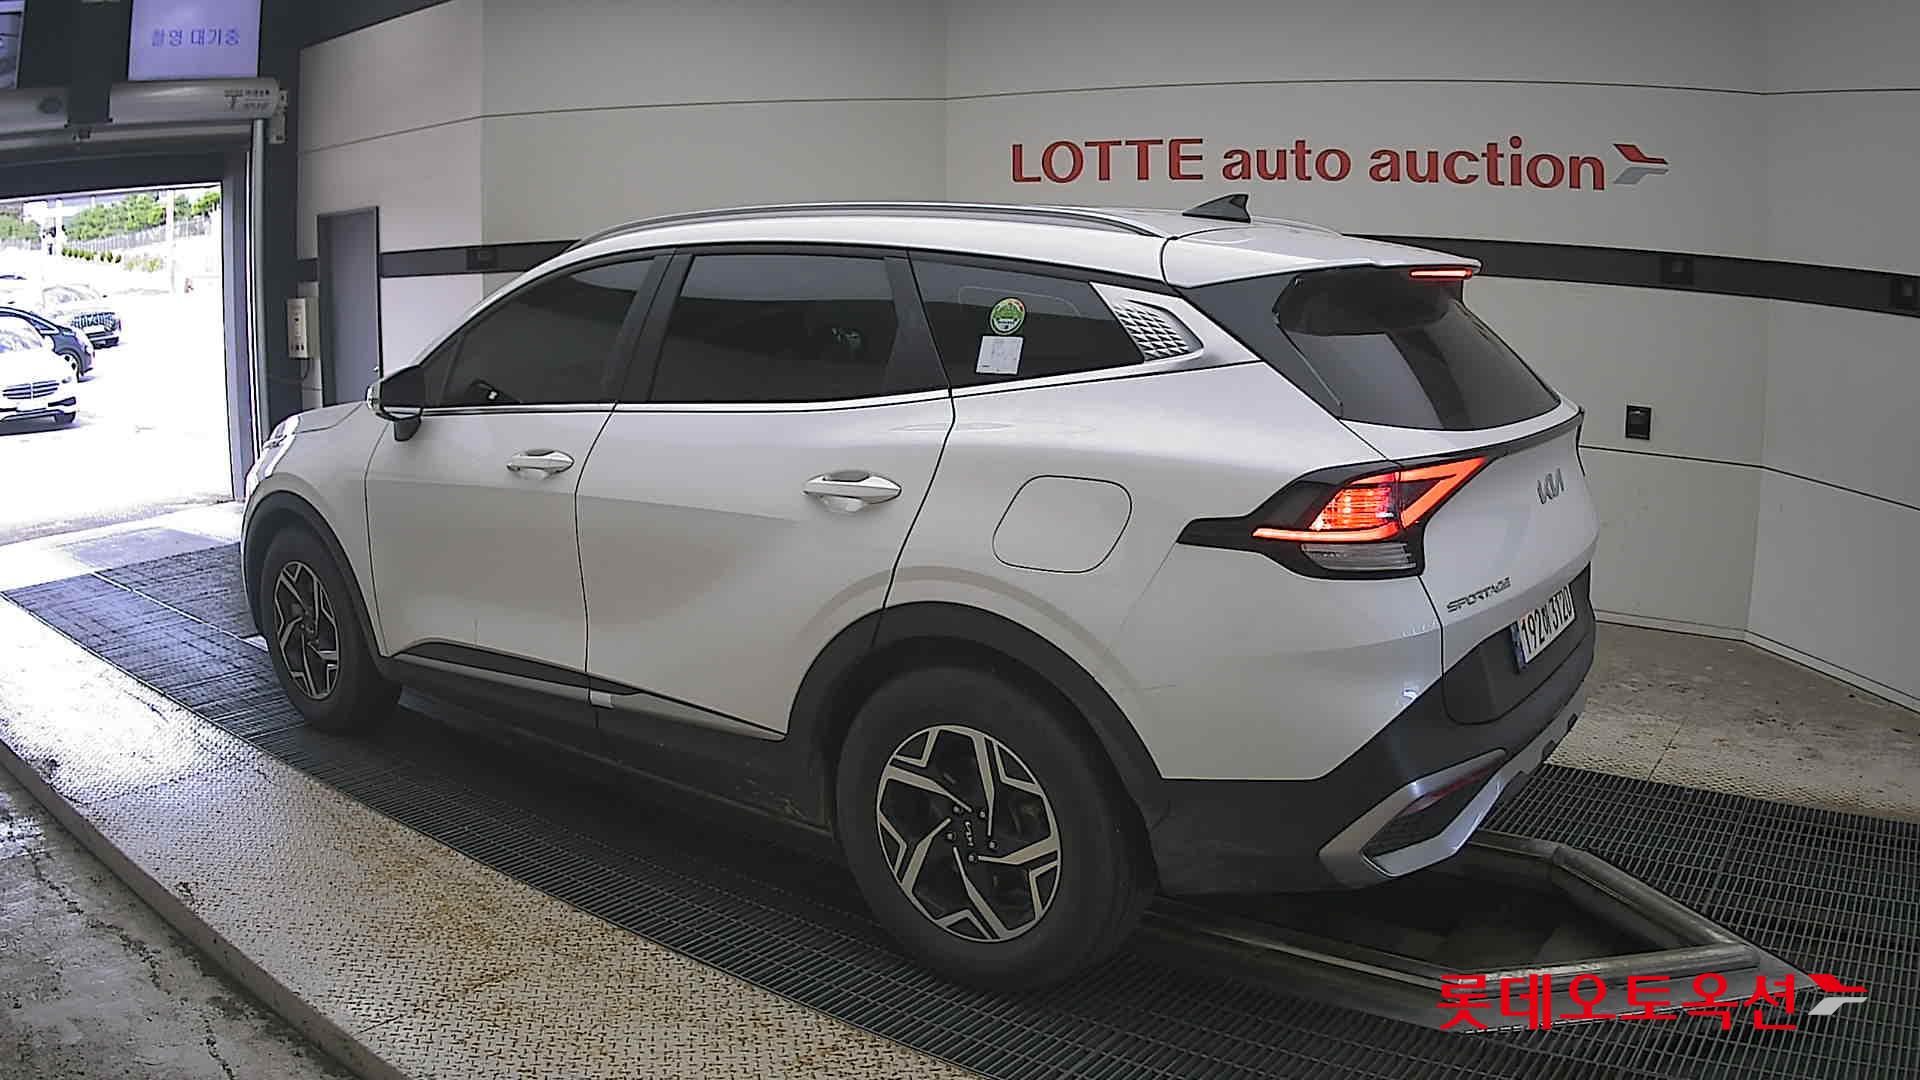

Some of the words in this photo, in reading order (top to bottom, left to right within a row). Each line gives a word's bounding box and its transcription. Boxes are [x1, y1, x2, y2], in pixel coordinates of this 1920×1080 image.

[191, 27, 241, 47] 대기중
[1011, 138, 1205, 184] LOTTE
[1222, 140, 1353, 183] auto
[1368, 136, 1607, 191] auction
